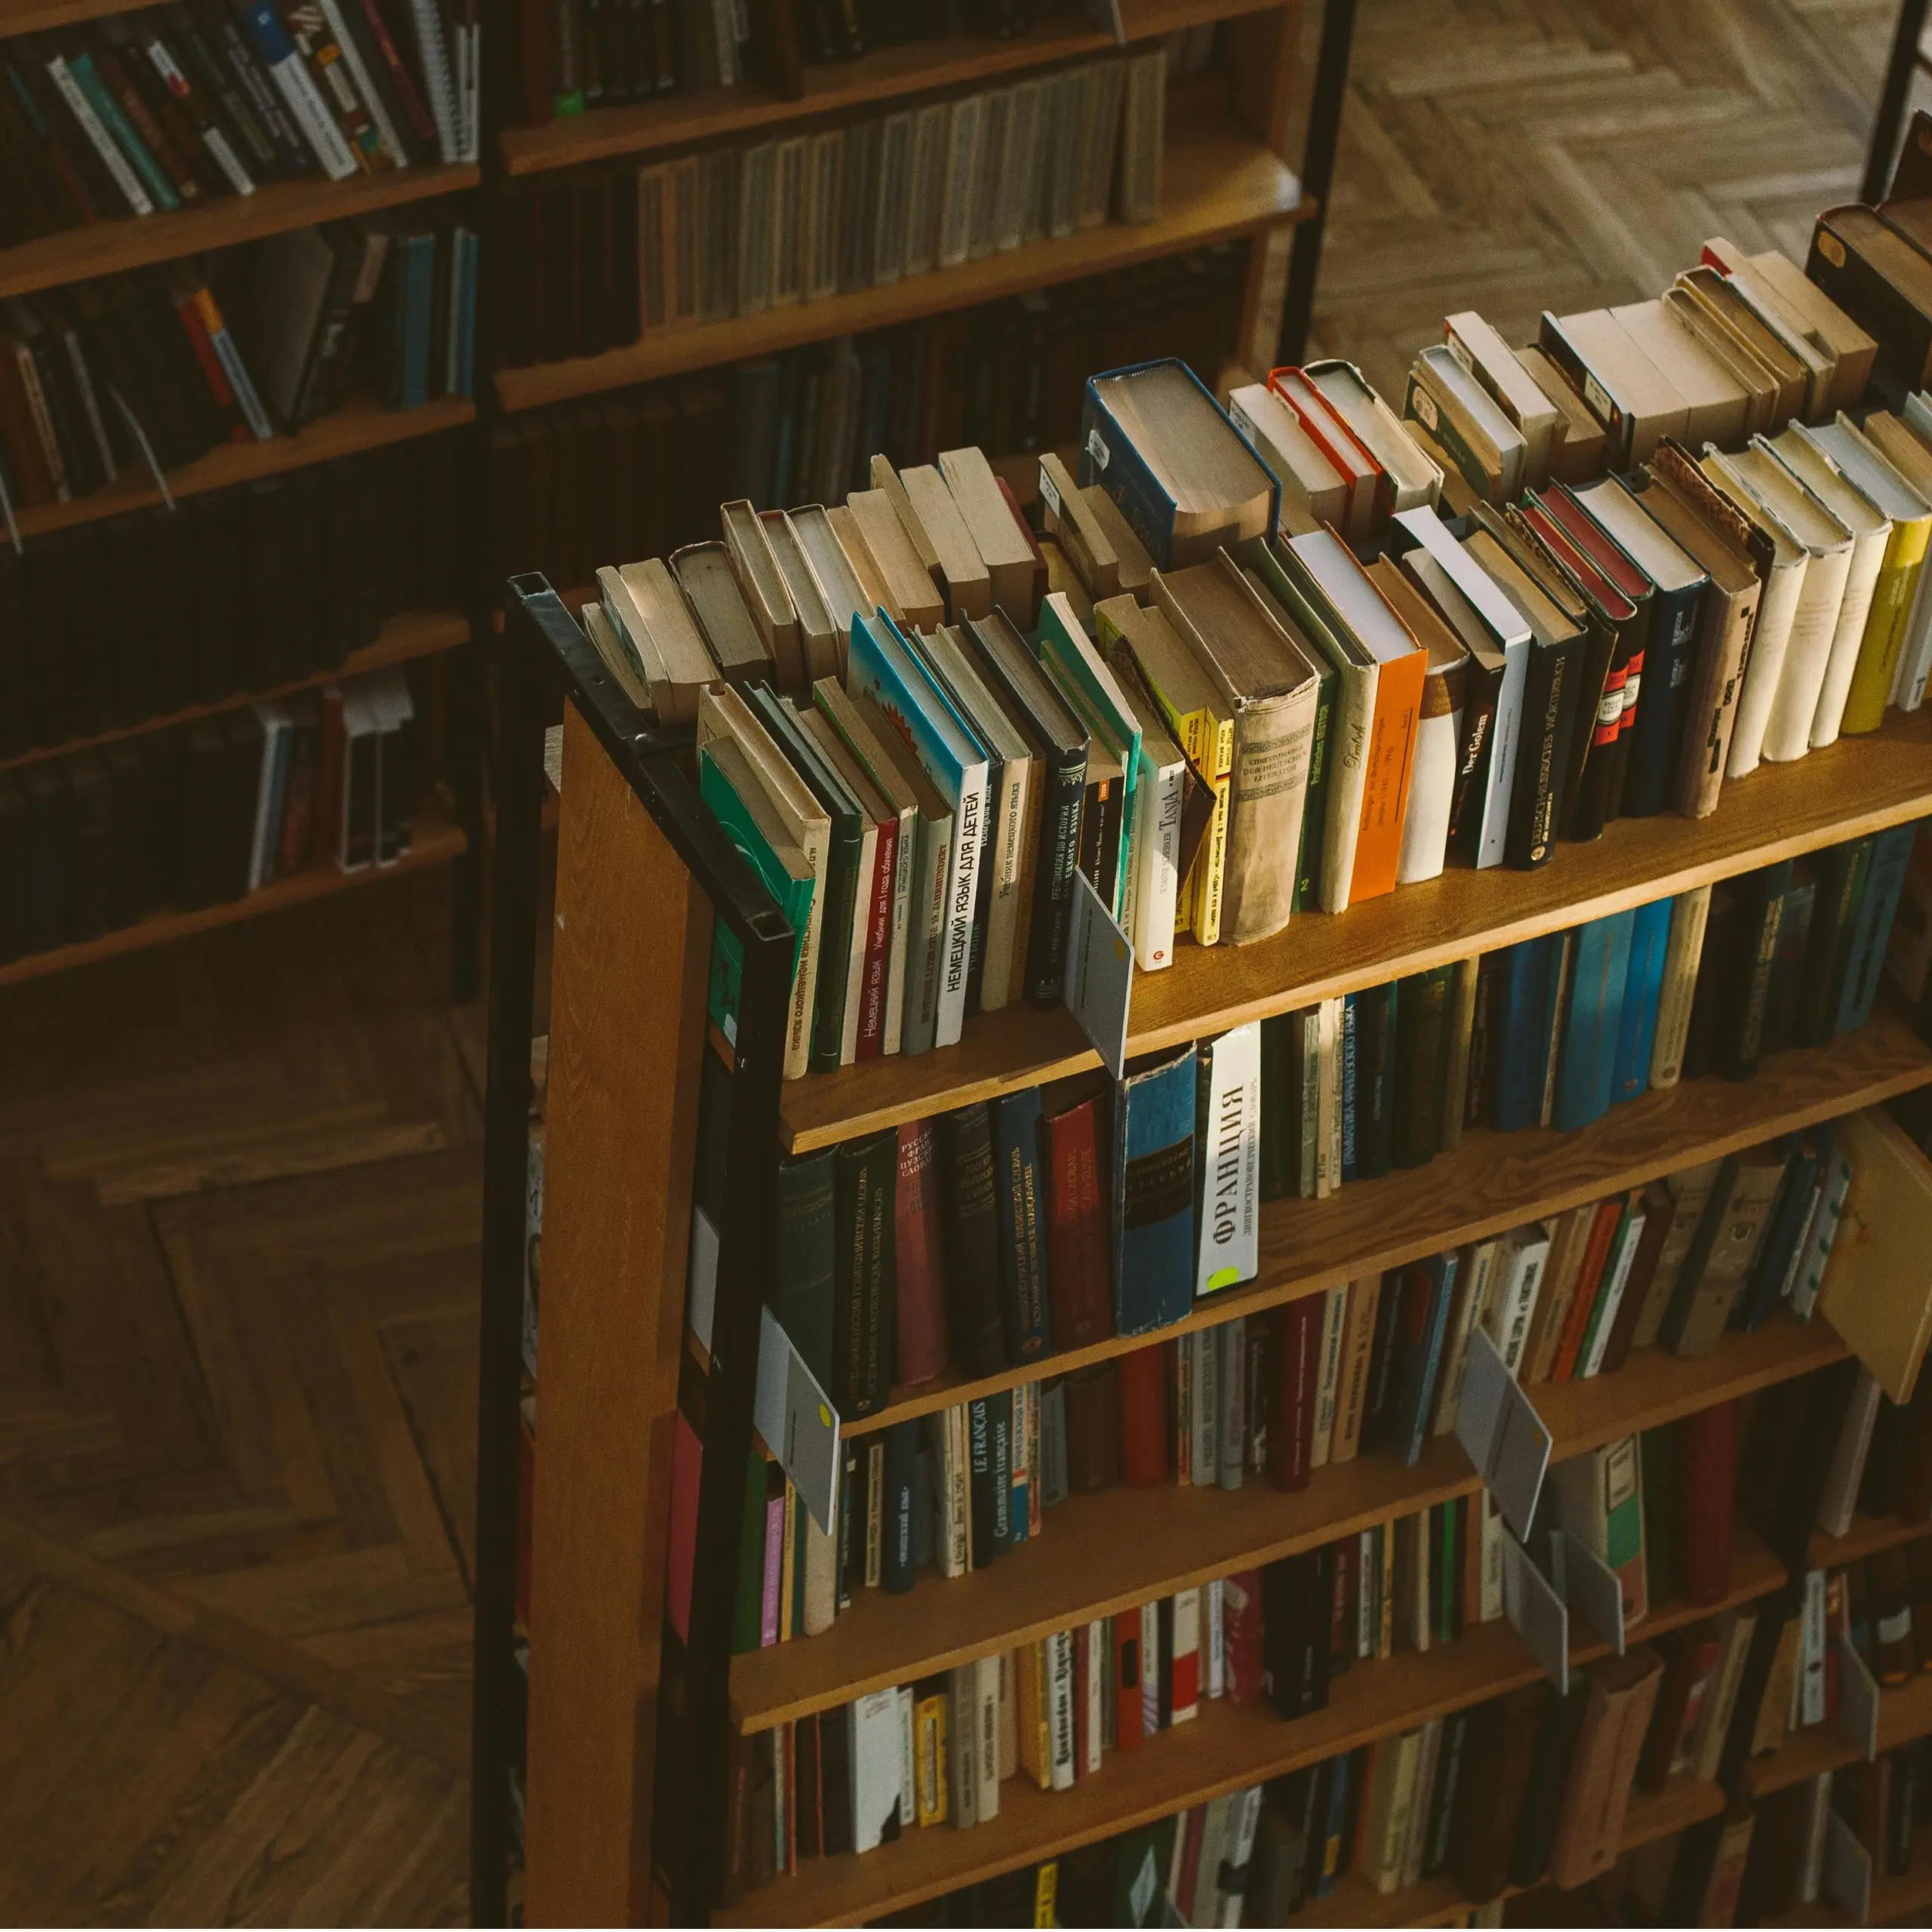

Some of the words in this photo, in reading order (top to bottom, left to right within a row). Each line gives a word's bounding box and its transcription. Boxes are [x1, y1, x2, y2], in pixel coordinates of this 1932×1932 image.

[1469, 715, 1487, 751] Golem
[1243, 766, 1261, 776] DER
[1462, 752, 1477, 774] Der
[984, 783, 992, 804] язык
[1011, 783, 1020, 809] языка
[1158, 791, 1178, 829] TANJA
[961, 792, 978, 836] ДЕТЕЙ
[980, 805, 992, 846] Немецкий
[1058, 805, 1069, 839] ИСТОРИИ
[901, 833, 910, 855] ЯЗЫКА
[1005, 812, 1017, 858] немецкого
[1057, 840, 1066, 852] ПО
[1063, 841, 1075, 895] НЕМЕЦКОГО
[1070, 800, 1079, 834] ЯЗЫКА
[882, 838, 892, 872] обучения
[899, 855, 909, 892] НЕМЕЦКОГО
[960, 841, 974, 869] ДЛЯ
[956, 874, 971, 912] ЯЗЫК
[1000, 859, 1012, 897] Учебник
[1051, 852, 1064, 900] ХРЕСТОМАТИЯ
[874, 917, 884, 949] Учебник
[871, 960, 881, 984] язык
[946, 916, 967, 991] НЕМЕЦКИЙ
[795, 960, 808, 1016] немецкого
[864, 988, 878, 1037] Немецкий
[792, 1020, 801, 1051] языка
[1249, 1077, 1258, 1118] СЛОВАРЬ
[1011, 1147, 1020, 1181] СЛОВАРЬ
[1212, 1084, 1245, 1245] ФРАНЦИЯ
[1242, 1123, 1257, 1234] ЛИНГВОСТРАНОВЕДЧЕСКИЙ
[857, 1166, 866, 1205] СЛОВАРЬ
[853, 1208, 864, 1295] ПОЛИТЕХНИЧЕСКИЙ
[971, 1401, 987, 1457] FRANÇAIS
[994, 1423, 1008, 1472] française
[973, 1457, 986, 1473] LE
[995, 1475, 1009, 1537] Grammaire
